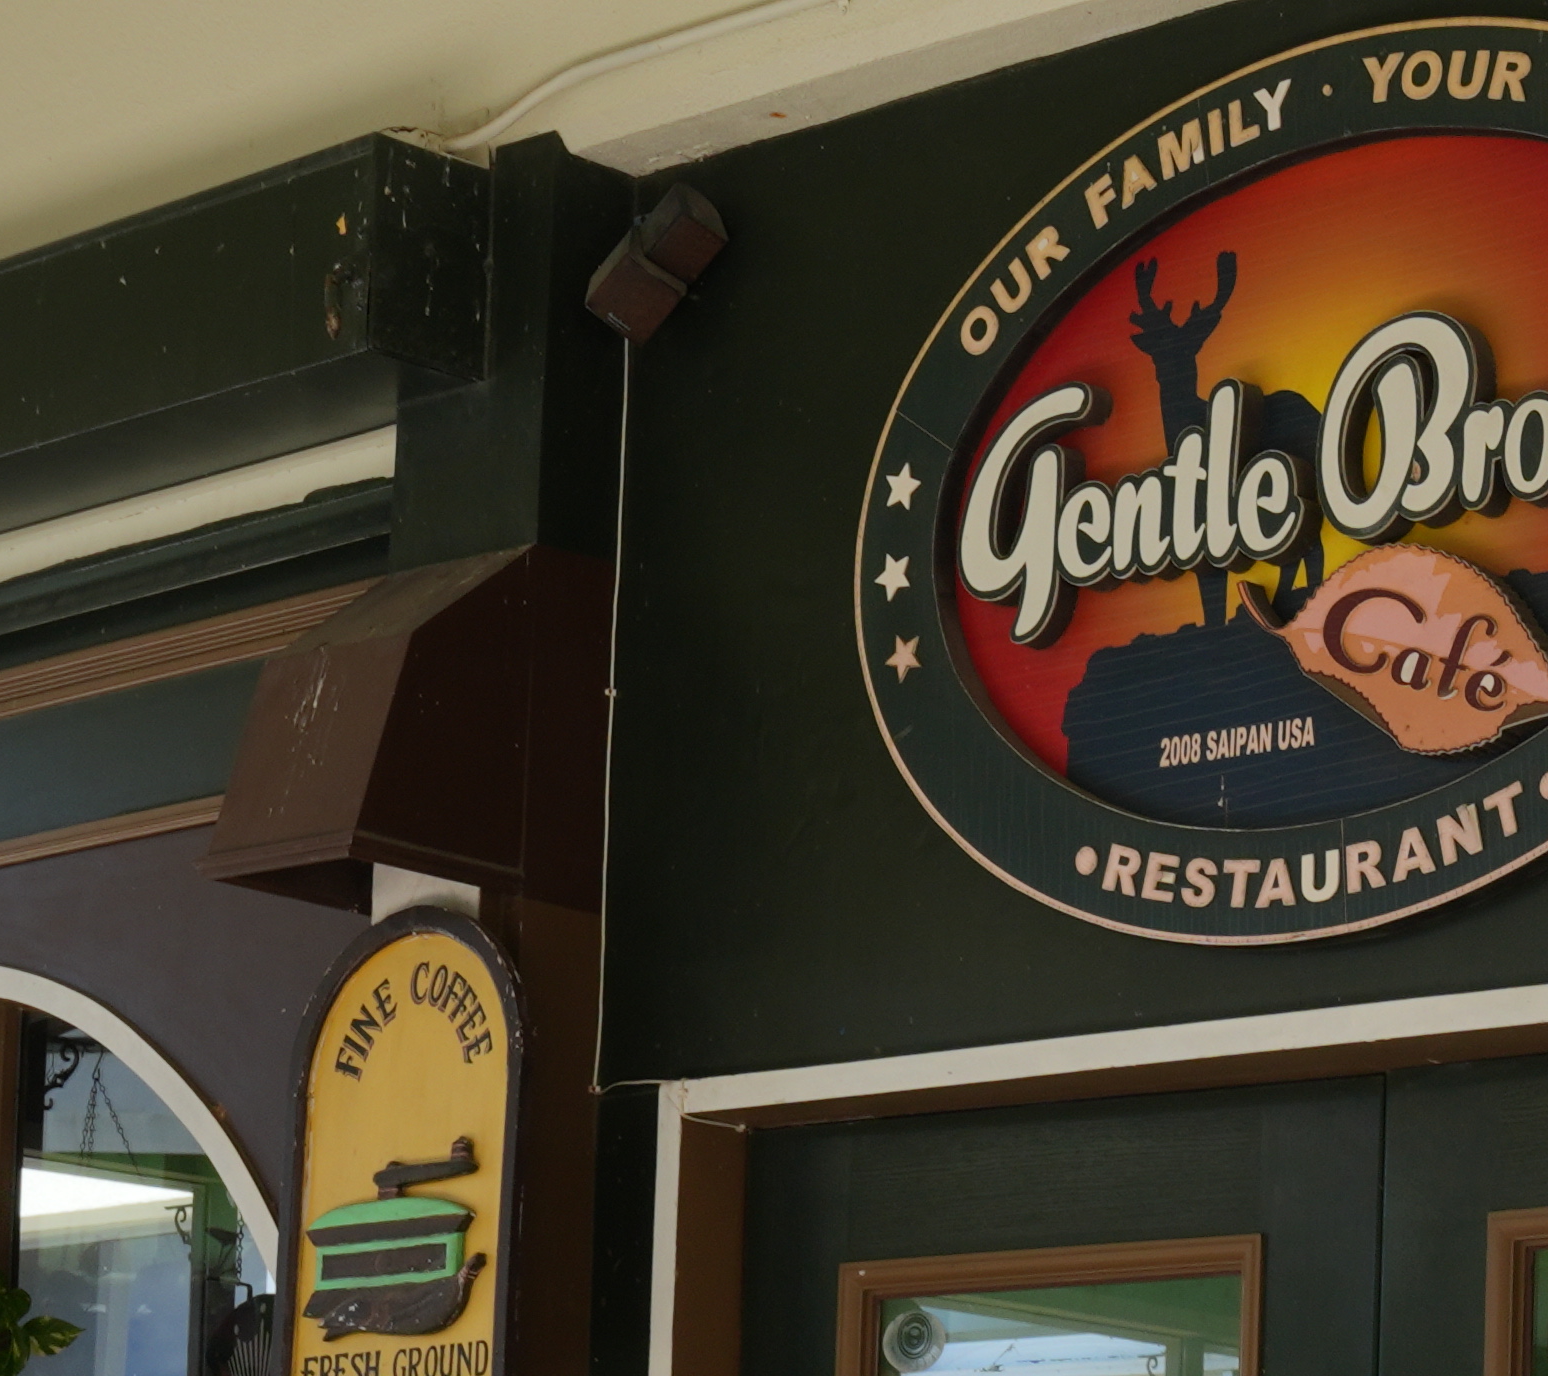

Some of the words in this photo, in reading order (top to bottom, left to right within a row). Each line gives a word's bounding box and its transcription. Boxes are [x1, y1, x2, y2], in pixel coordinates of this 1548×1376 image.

[1361, 49, 1532, 106] YOUR
[958, 226, 1072, 358] OUR
[1084, 79, 1294, 230] FAMILY
[960, 382, 1298, 645] Gentle
[1320, 585, 1508, 714] Café
[1158, 735, 1201, 768] 2008
[1205, 724, 1272, 762] SAIPAN
[1275, 716, 1316, 752] USA
[1101, 780, 1526, 910] RESTAURANT
[334, 978, 399, 1081] FINE
[409, 960, 494, 1065] COFFEE
